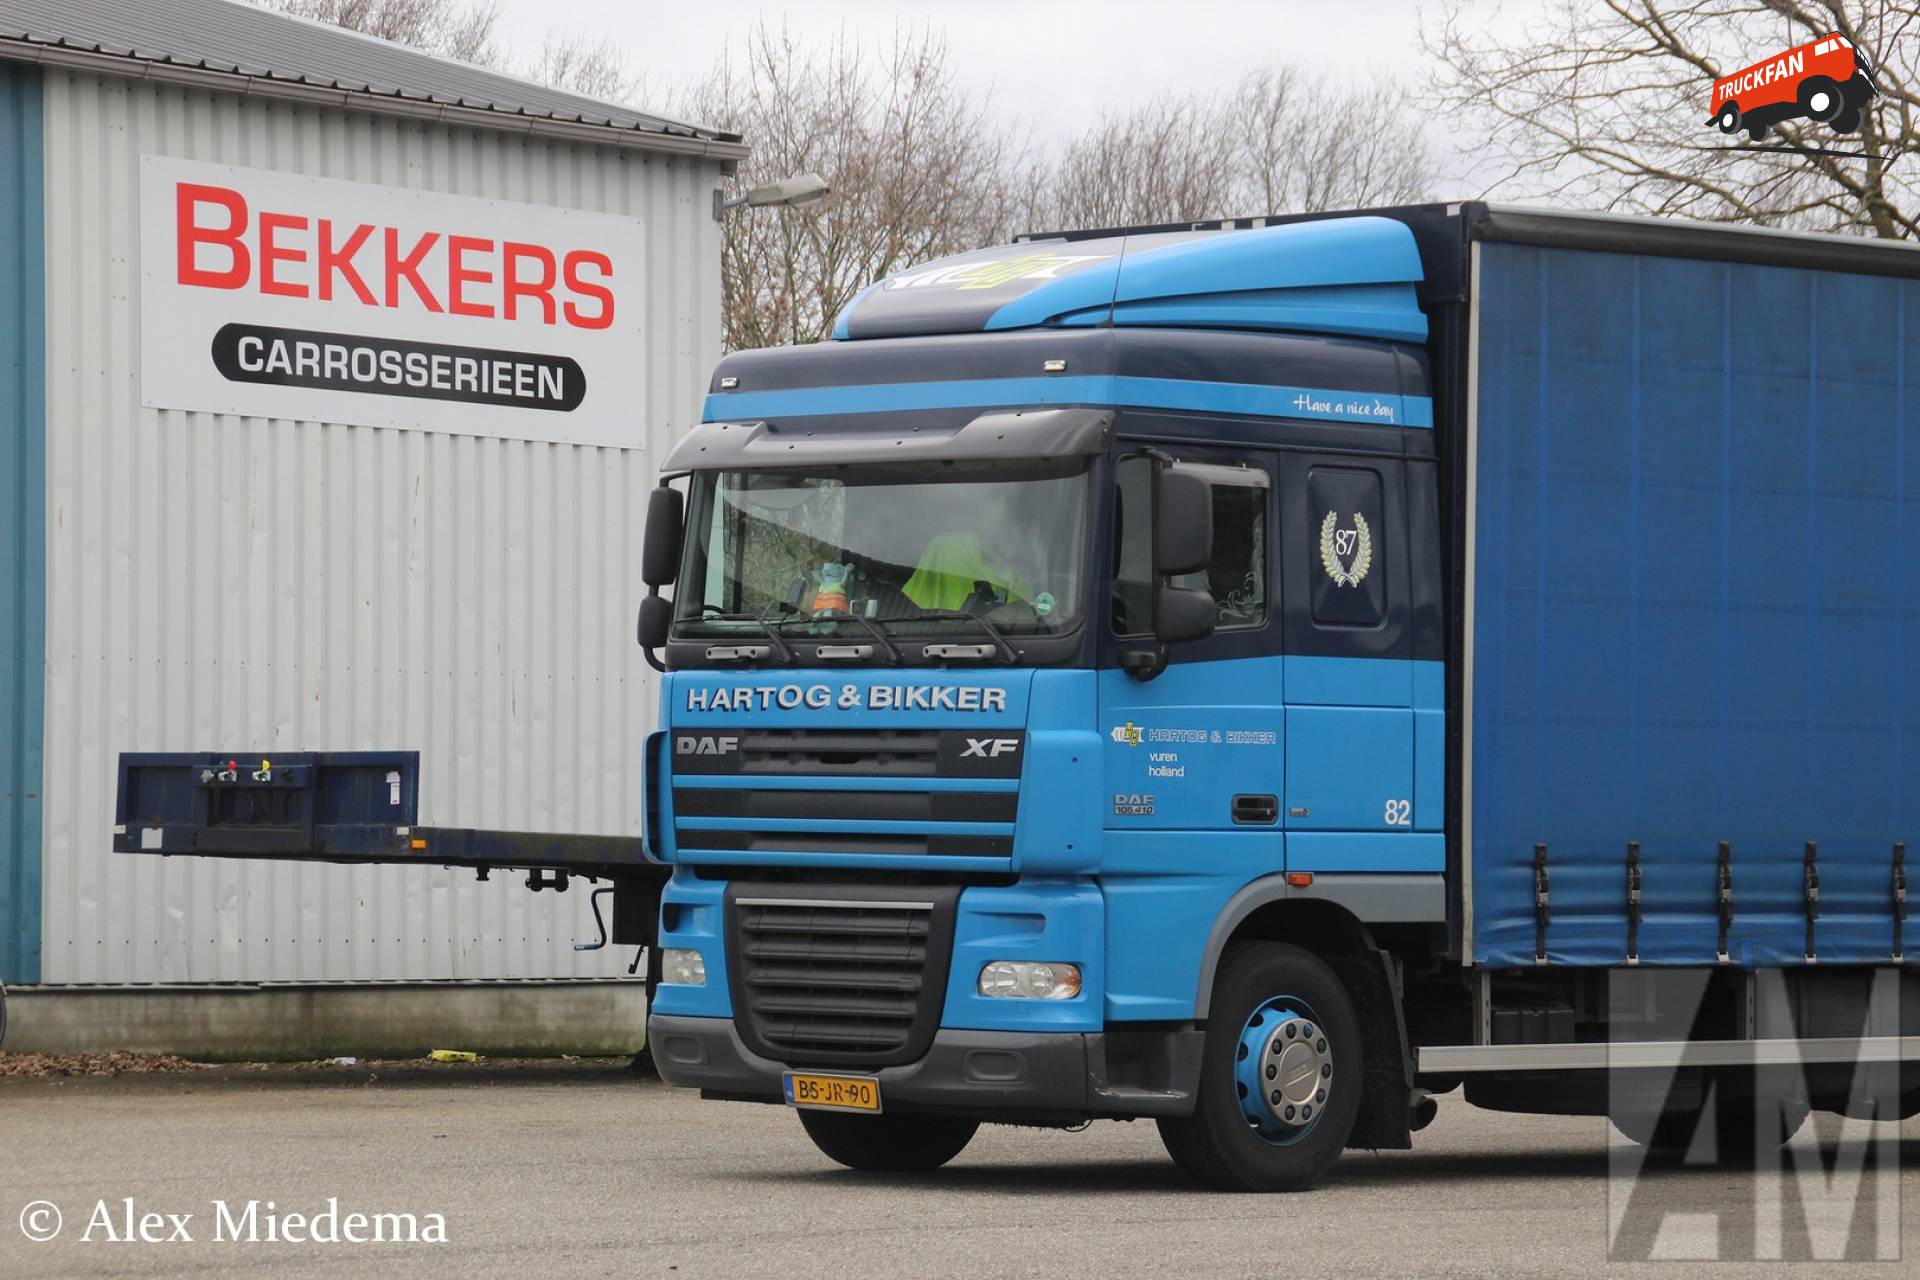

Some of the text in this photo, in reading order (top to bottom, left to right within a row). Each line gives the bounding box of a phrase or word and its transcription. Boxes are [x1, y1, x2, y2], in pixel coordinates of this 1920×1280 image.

[176, 182, 616, 330] BEKKERS
[237, 336, 564, 401] CARROSSERIEEN
[1293, 394, 1395, 423] Have a nice day
[1335, 529, 1357, 555] 87
[686, 684, 1007, 713] HARTOG & BIKKER
[676, 736, 738, 755] DAF
[959, 738, 1019, 758] XF
[1149, 752, 1178, 762] vuren
[1148, 765, 1185, 777] holland
[1113, 793, 1155, 805] DAF
[1383, 799, 1411, 825] 82
[798, 1080, 871, 1104] BS-JR-90
